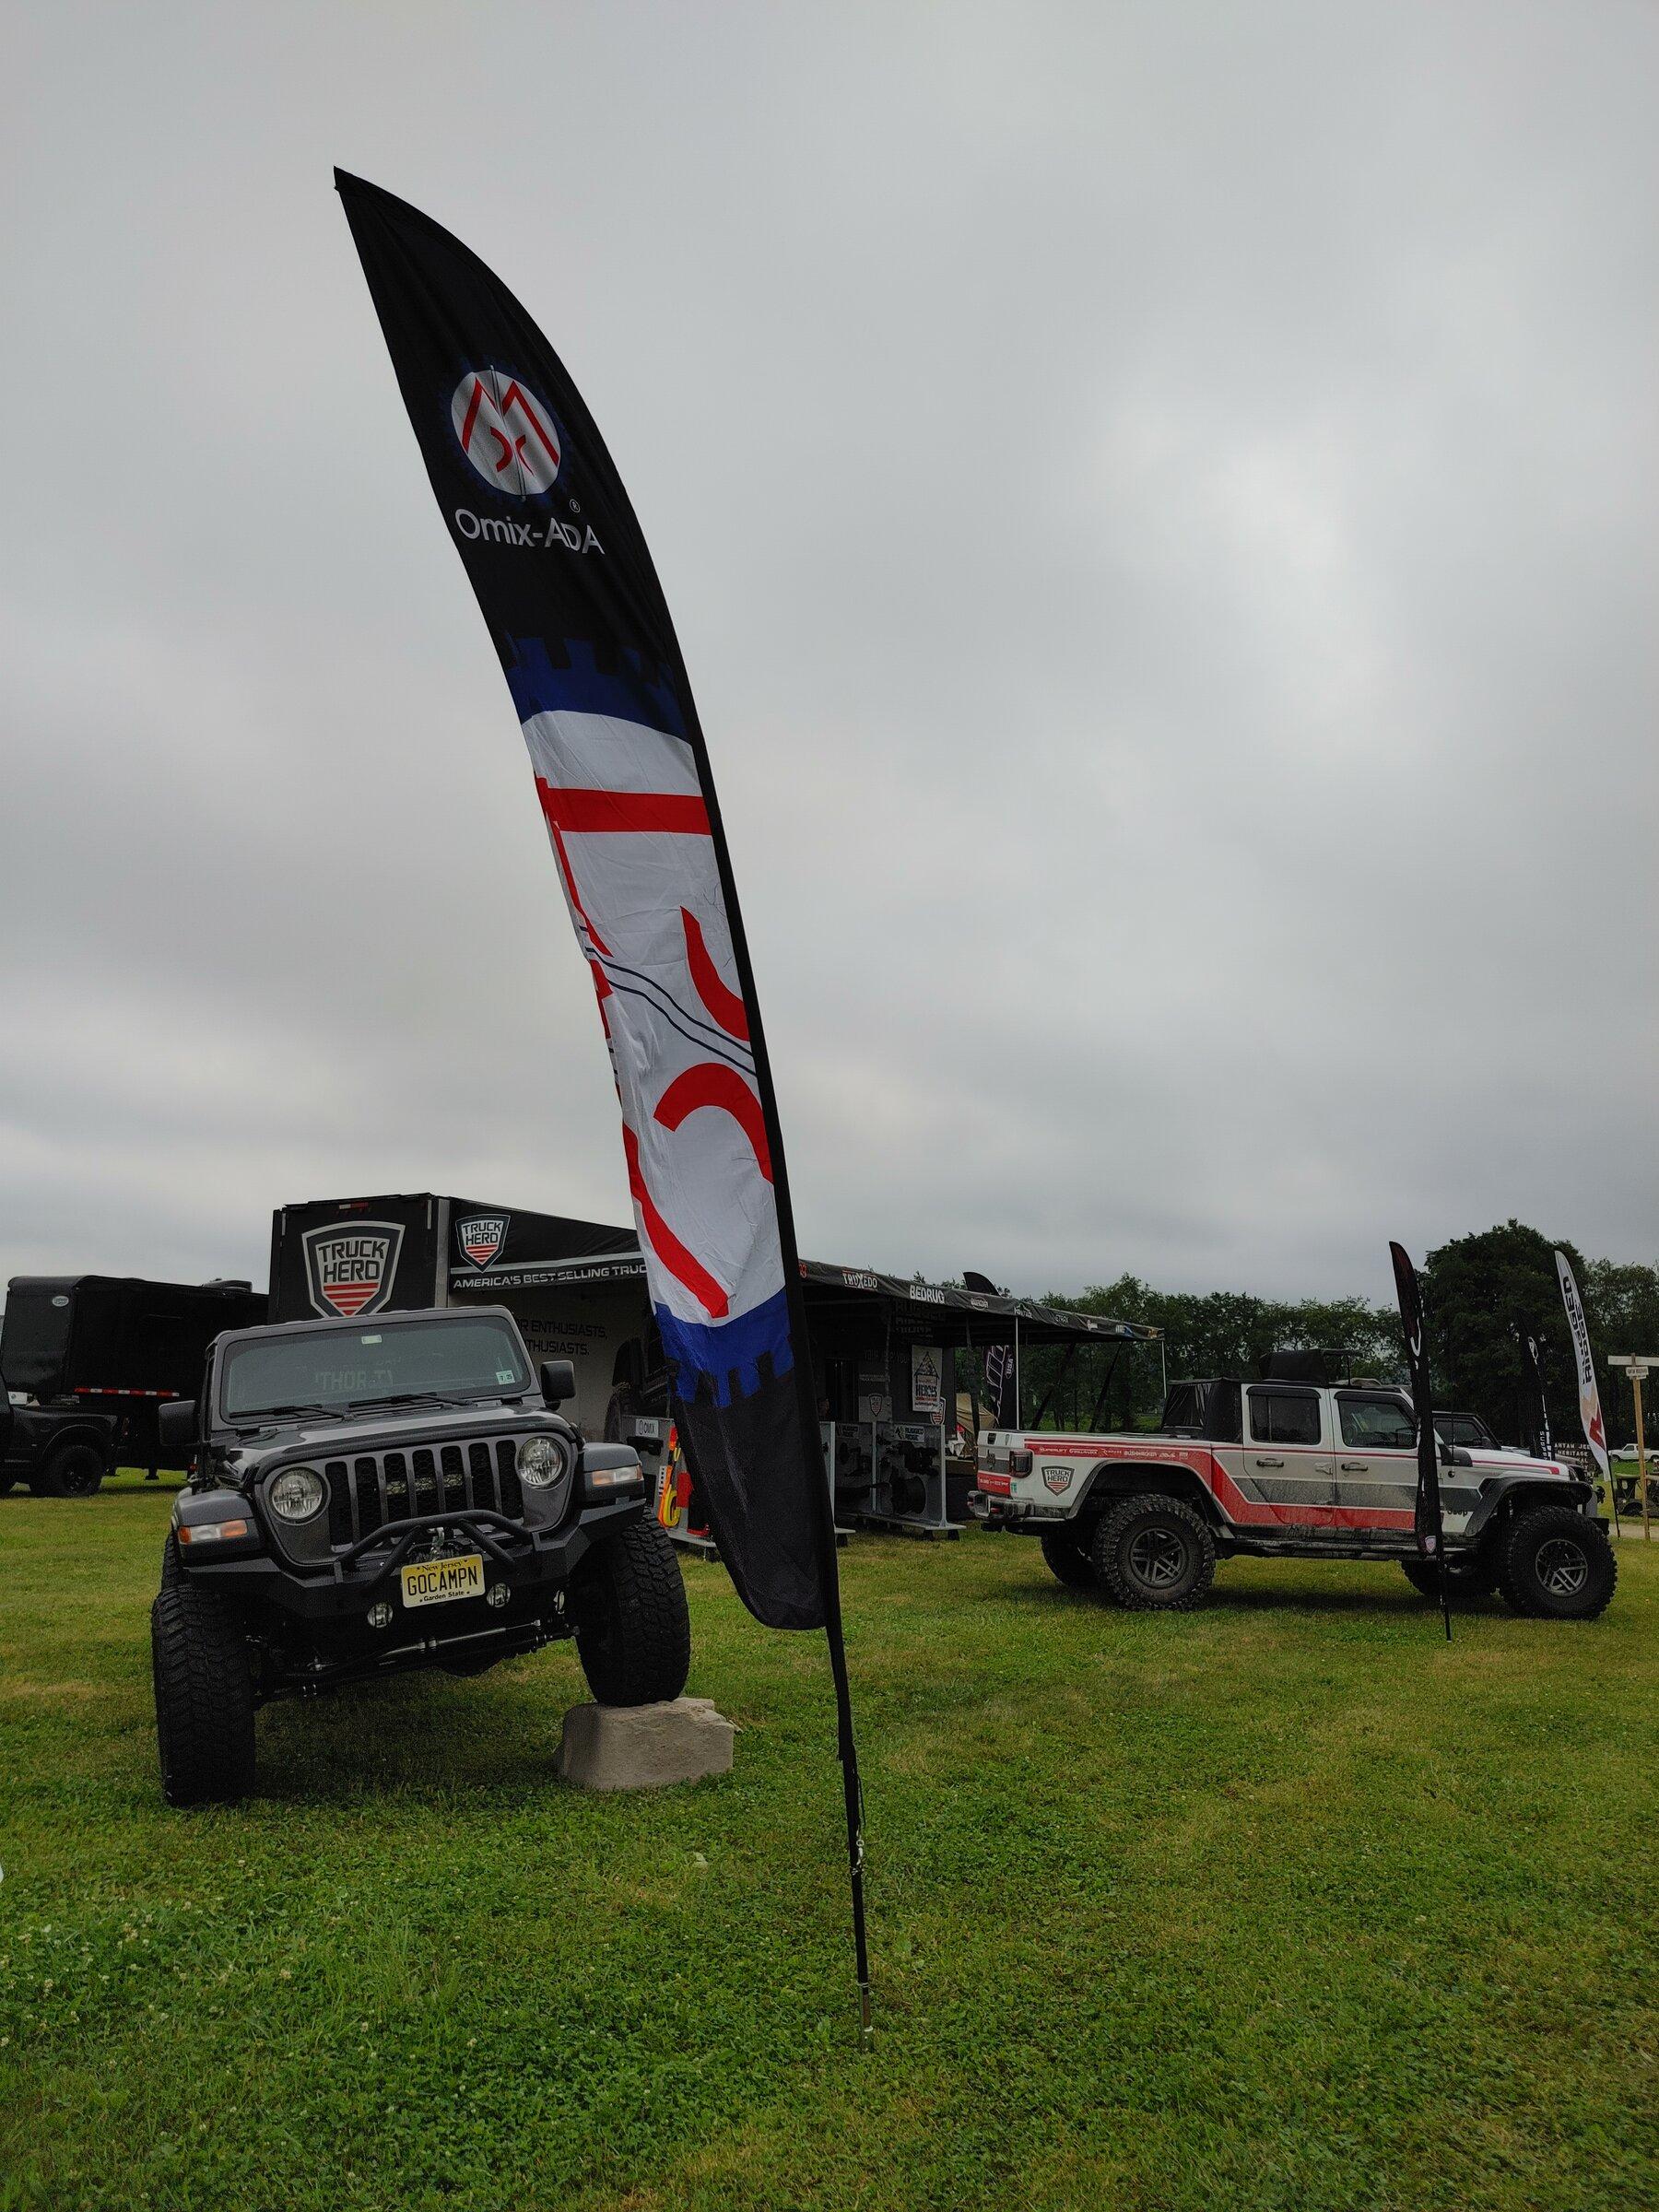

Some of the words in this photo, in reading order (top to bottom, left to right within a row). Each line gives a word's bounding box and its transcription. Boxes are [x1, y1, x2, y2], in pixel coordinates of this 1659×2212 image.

[454, 509, 605, 555] Omix-ADA
[463, 1221, 502, 1233] TRUCK
[465, 1231, 499, 1245] HERO
[318, 1240, 386, 1263] TRUCK
[324, 1259, 380, 1283] HERO
[453, 1276, 522, 1288] AMERICA'S
[523, 1272, 555, 1284] BEST
[558, 1266, 610, 1281] SELLING
[611, 1263, 648, 1276] TRUC
[842, 1271, 878, 1289] TRUXEDO
[909, 1284, 946, 1305] BEDRUG
[531, 1320, 608, 1340] ENTHUSIASTS,
[524, 1339, 590, 1356] THUSIASTS.
[1045, 1468, 1070, 1477] TRUCK
[1047, 1474, 1067, 1482] HERO
[407, 1566, 478, 1595] GOCAMPN
[424, 1594, 446, 1602] Garden
[448, 1590, 465, 1598] State
